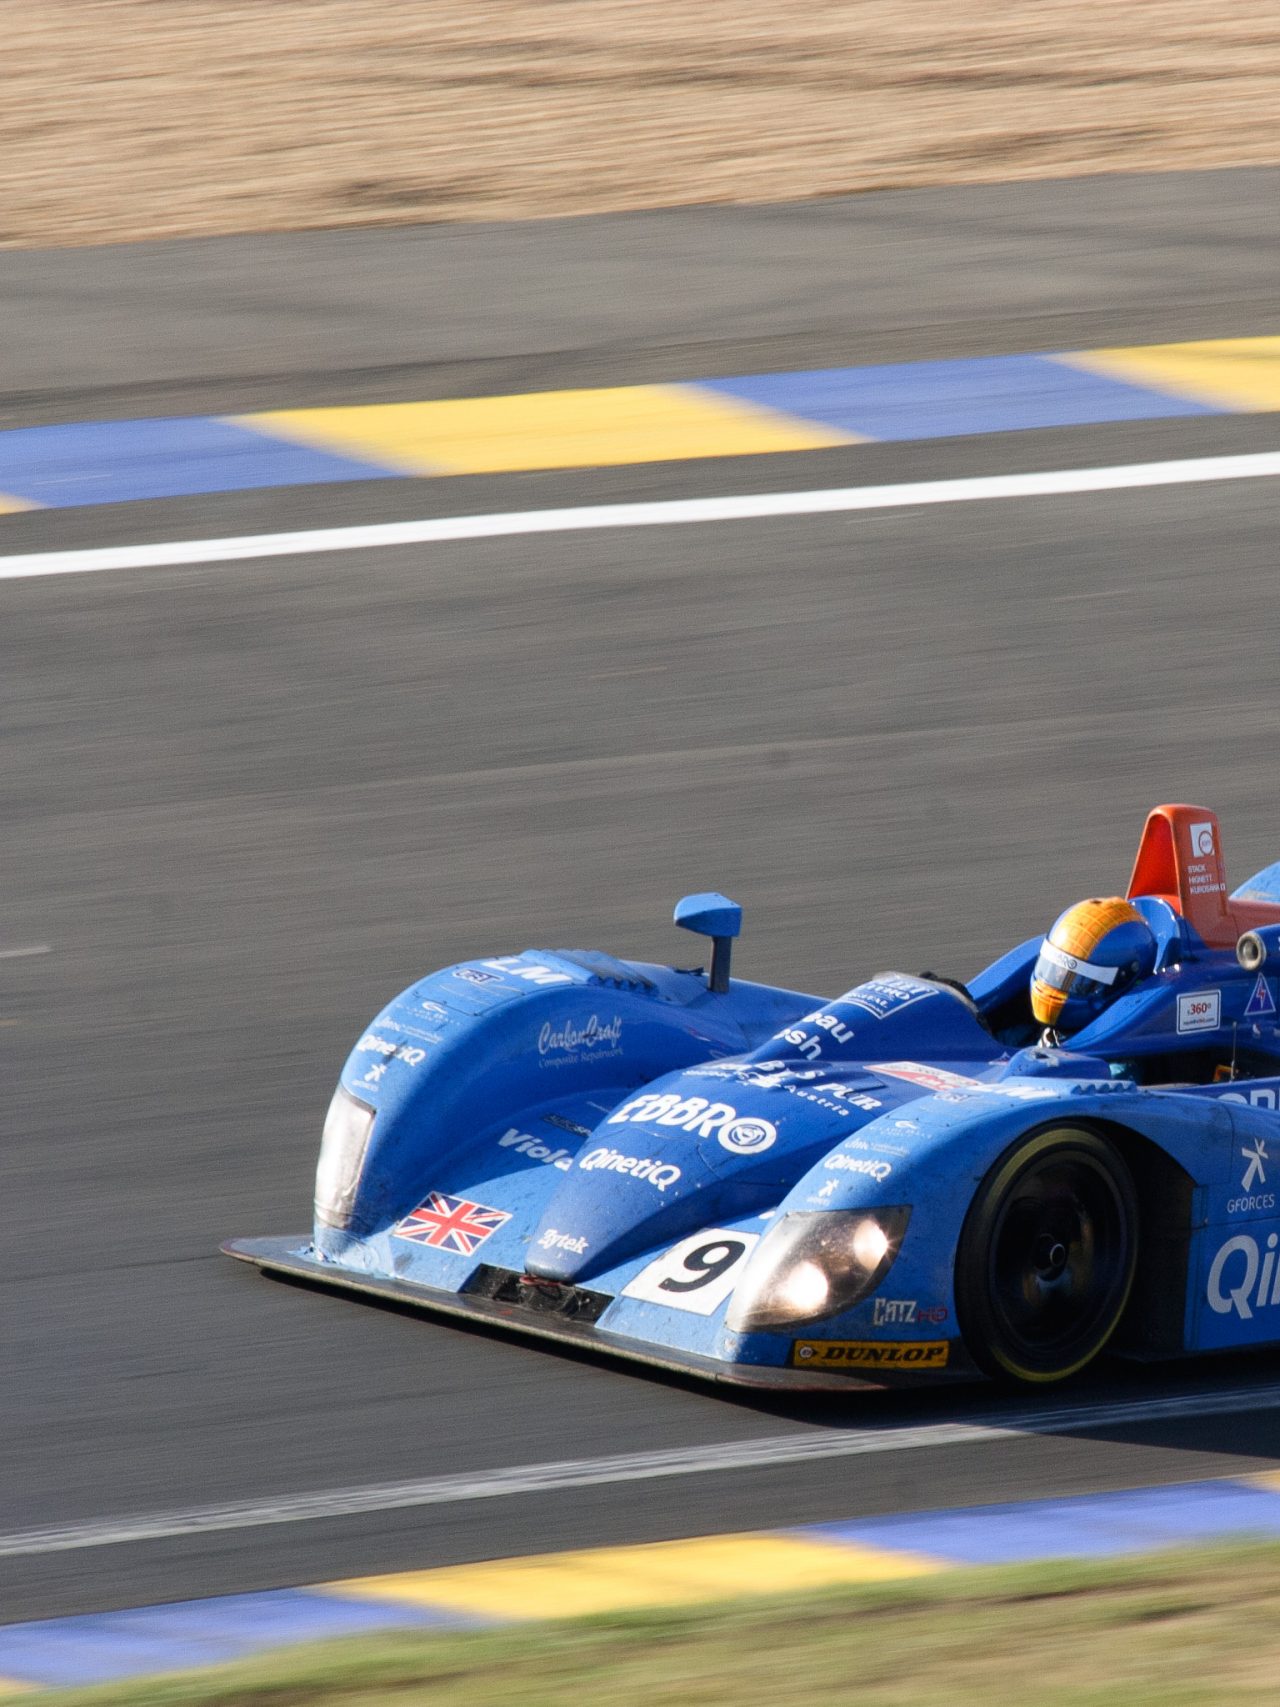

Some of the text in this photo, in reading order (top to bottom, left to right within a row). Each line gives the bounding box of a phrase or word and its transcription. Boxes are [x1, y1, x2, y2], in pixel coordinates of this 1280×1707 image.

[784, 1083, 850, 1116] Austria
[608, 1093, 777, 1155] EBBRO
[497, 1128, 574, 1172] Viola
[578, 1147, 682, 1192] QinetiQ
[823, 1153, 892, 1184] QinetiQ
[1227, 1194, 1275, 1213] GFORCES
[537, 1228, 590, 1255] Zytek
[658, 1239, 746, 1293] 9
[873, 1298, 918, 1326] CATZ
[821, 1347, 945, 1362] DUNLOP
